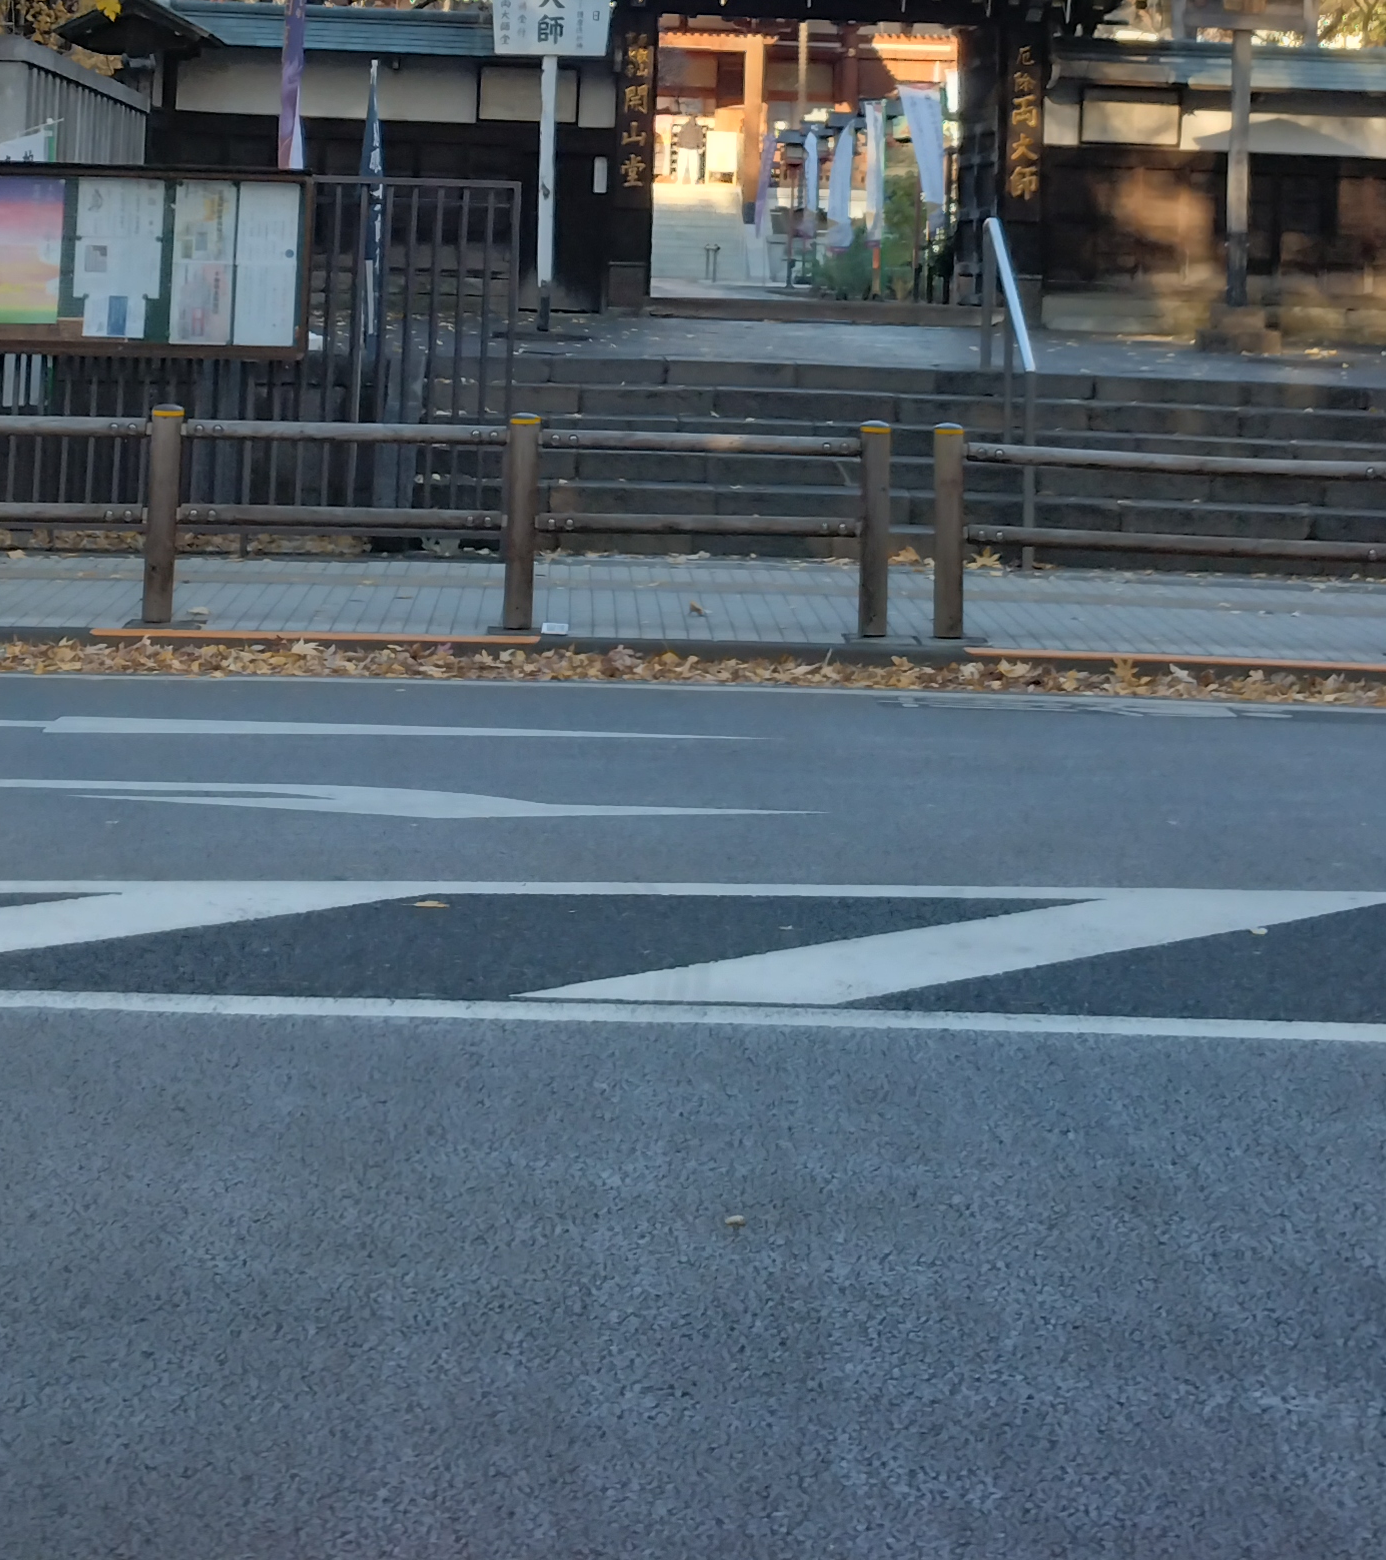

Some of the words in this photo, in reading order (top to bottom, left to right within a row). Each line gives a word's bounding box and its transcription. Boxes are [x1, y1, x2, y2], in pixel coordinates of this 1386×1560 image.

[620, 85, 649, 188] 開山堂
[1010, 44, 1039, 201] 厄除両大師
